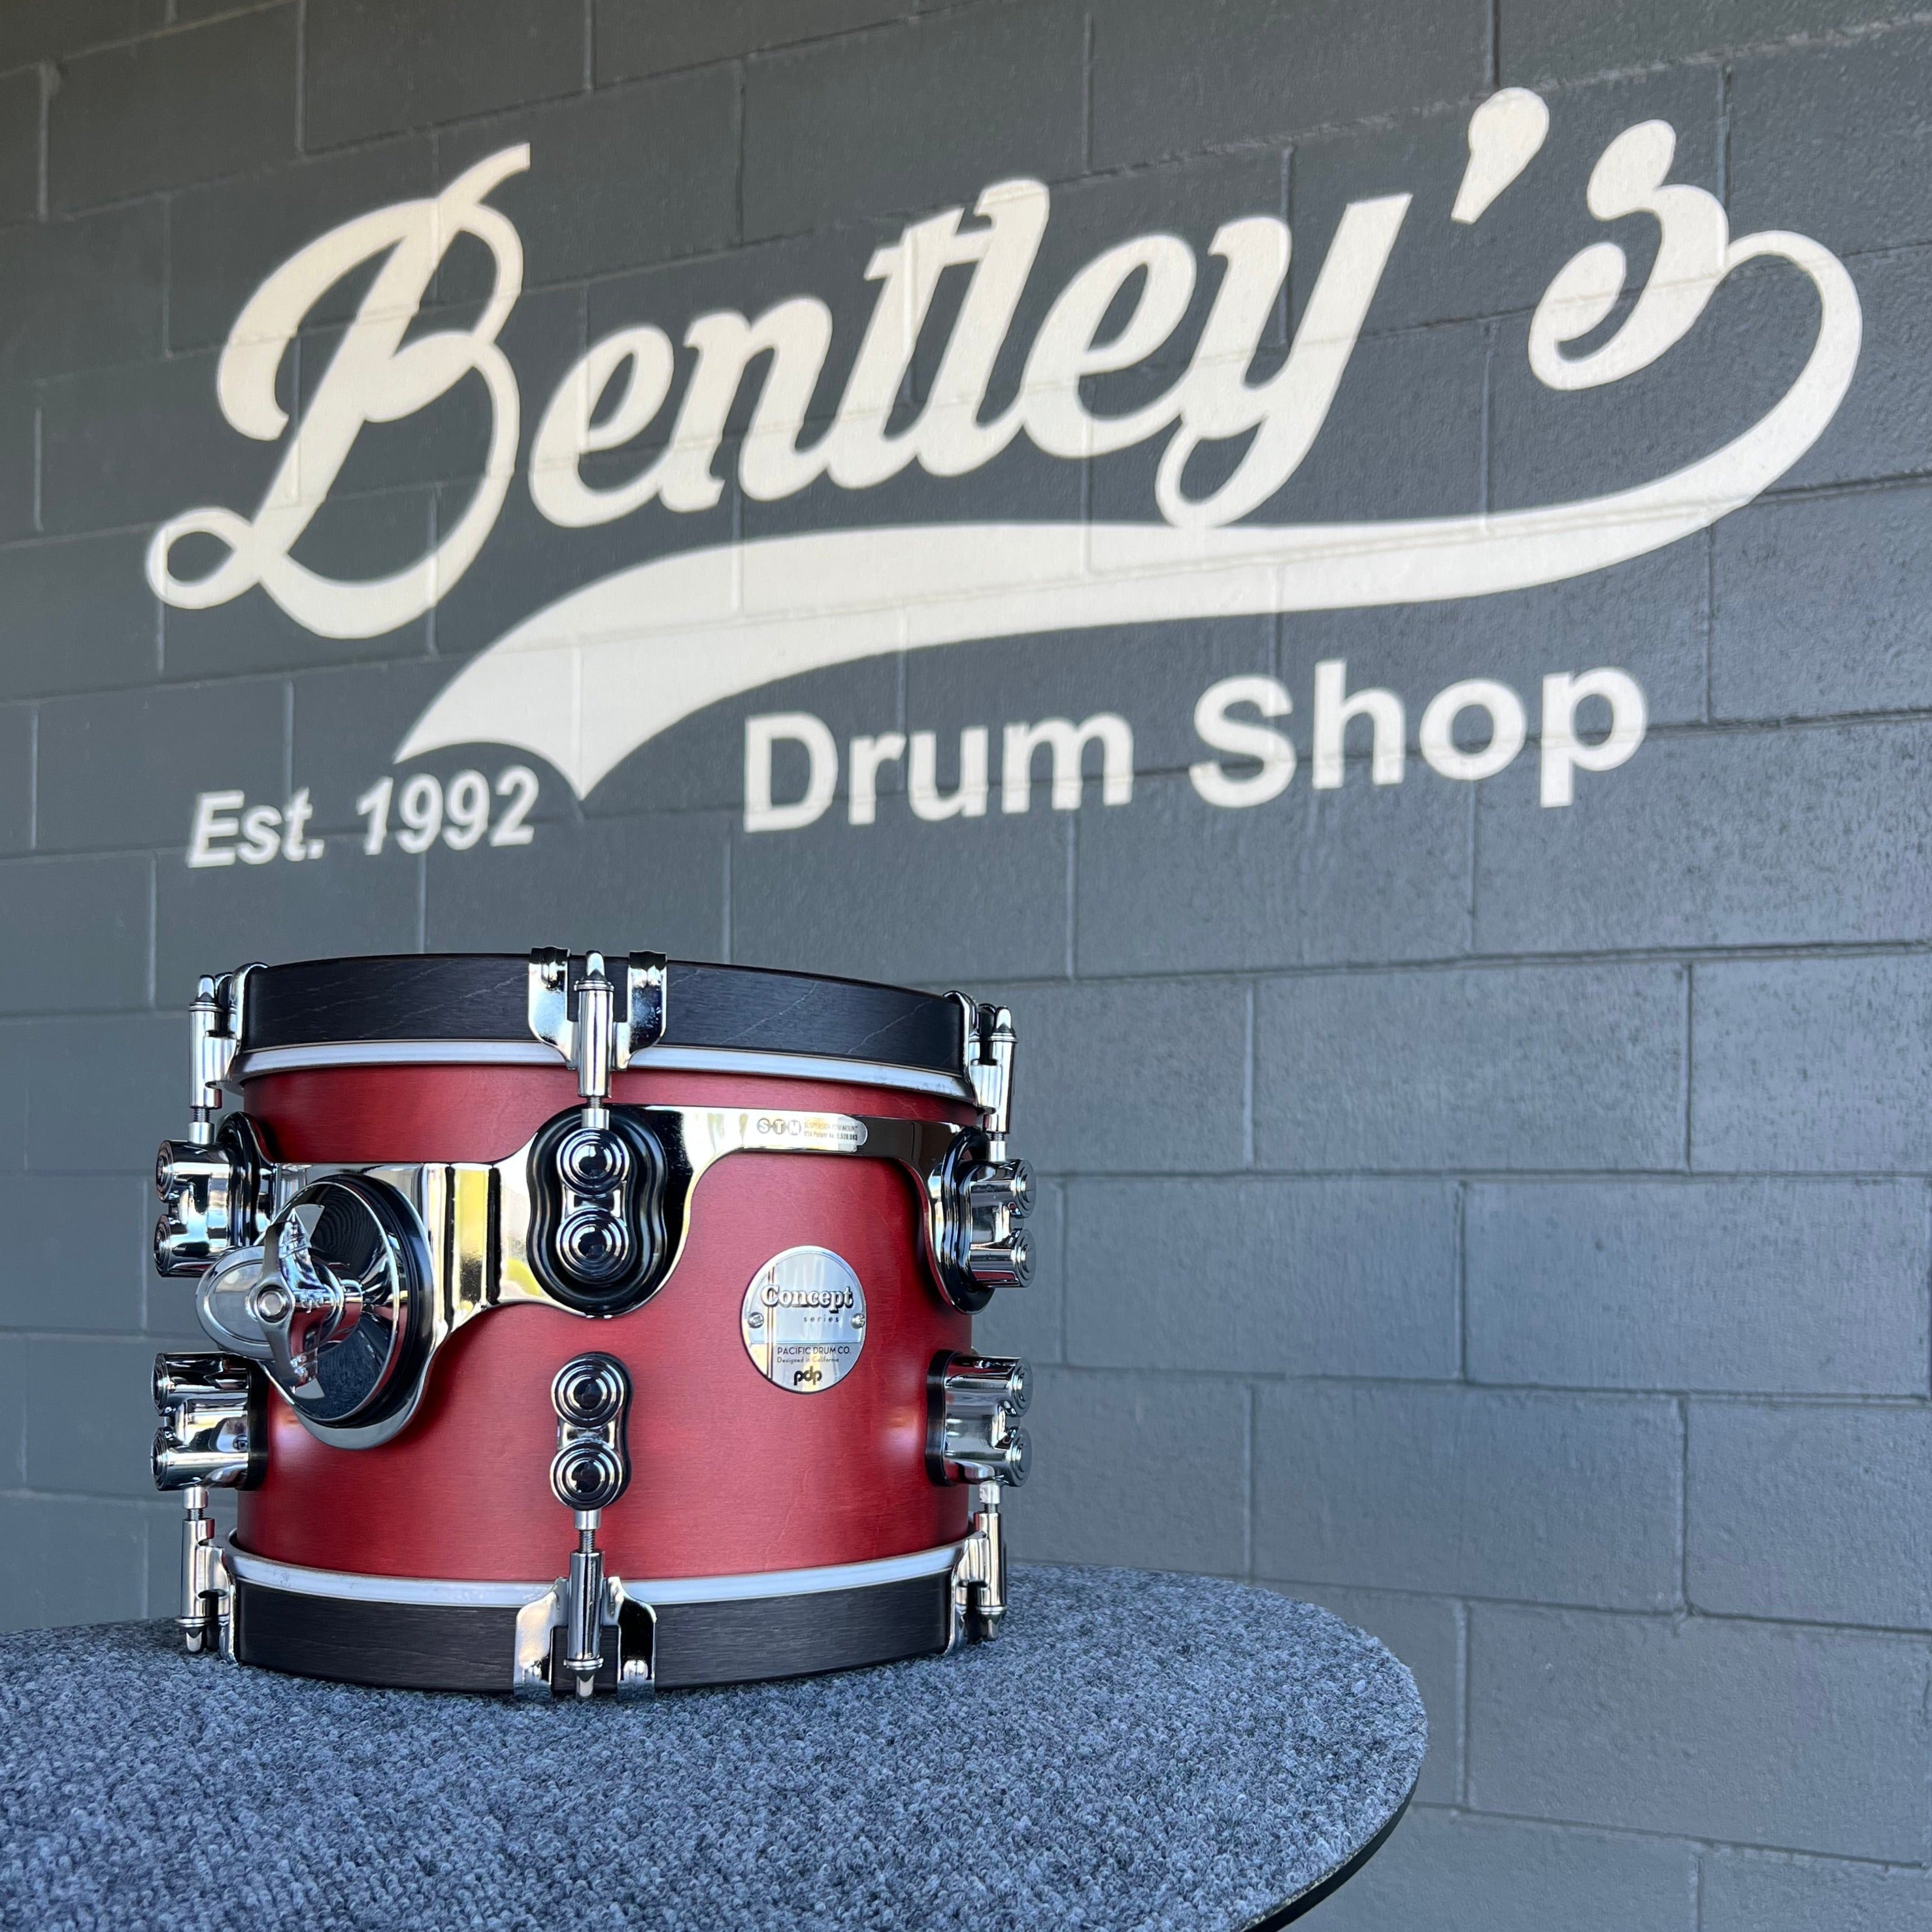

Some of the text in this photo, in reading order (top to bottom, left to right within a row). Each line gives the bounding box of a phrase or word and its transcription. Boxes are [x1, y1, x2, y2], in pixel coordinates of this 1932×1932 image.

[145, 87, 1863, 639] Bentley's
[743, 659, 1650, 833] Drum Shop
[187, 765, 539, 869] Est. 1992
[761, 1284, 854, 1314] Concept
[777, 1346, 852, 1355] PACIFIC DRUM CO.
[777, 1356, 804, 1365] Designed
[794, 1365, 823, 1386] pdp
